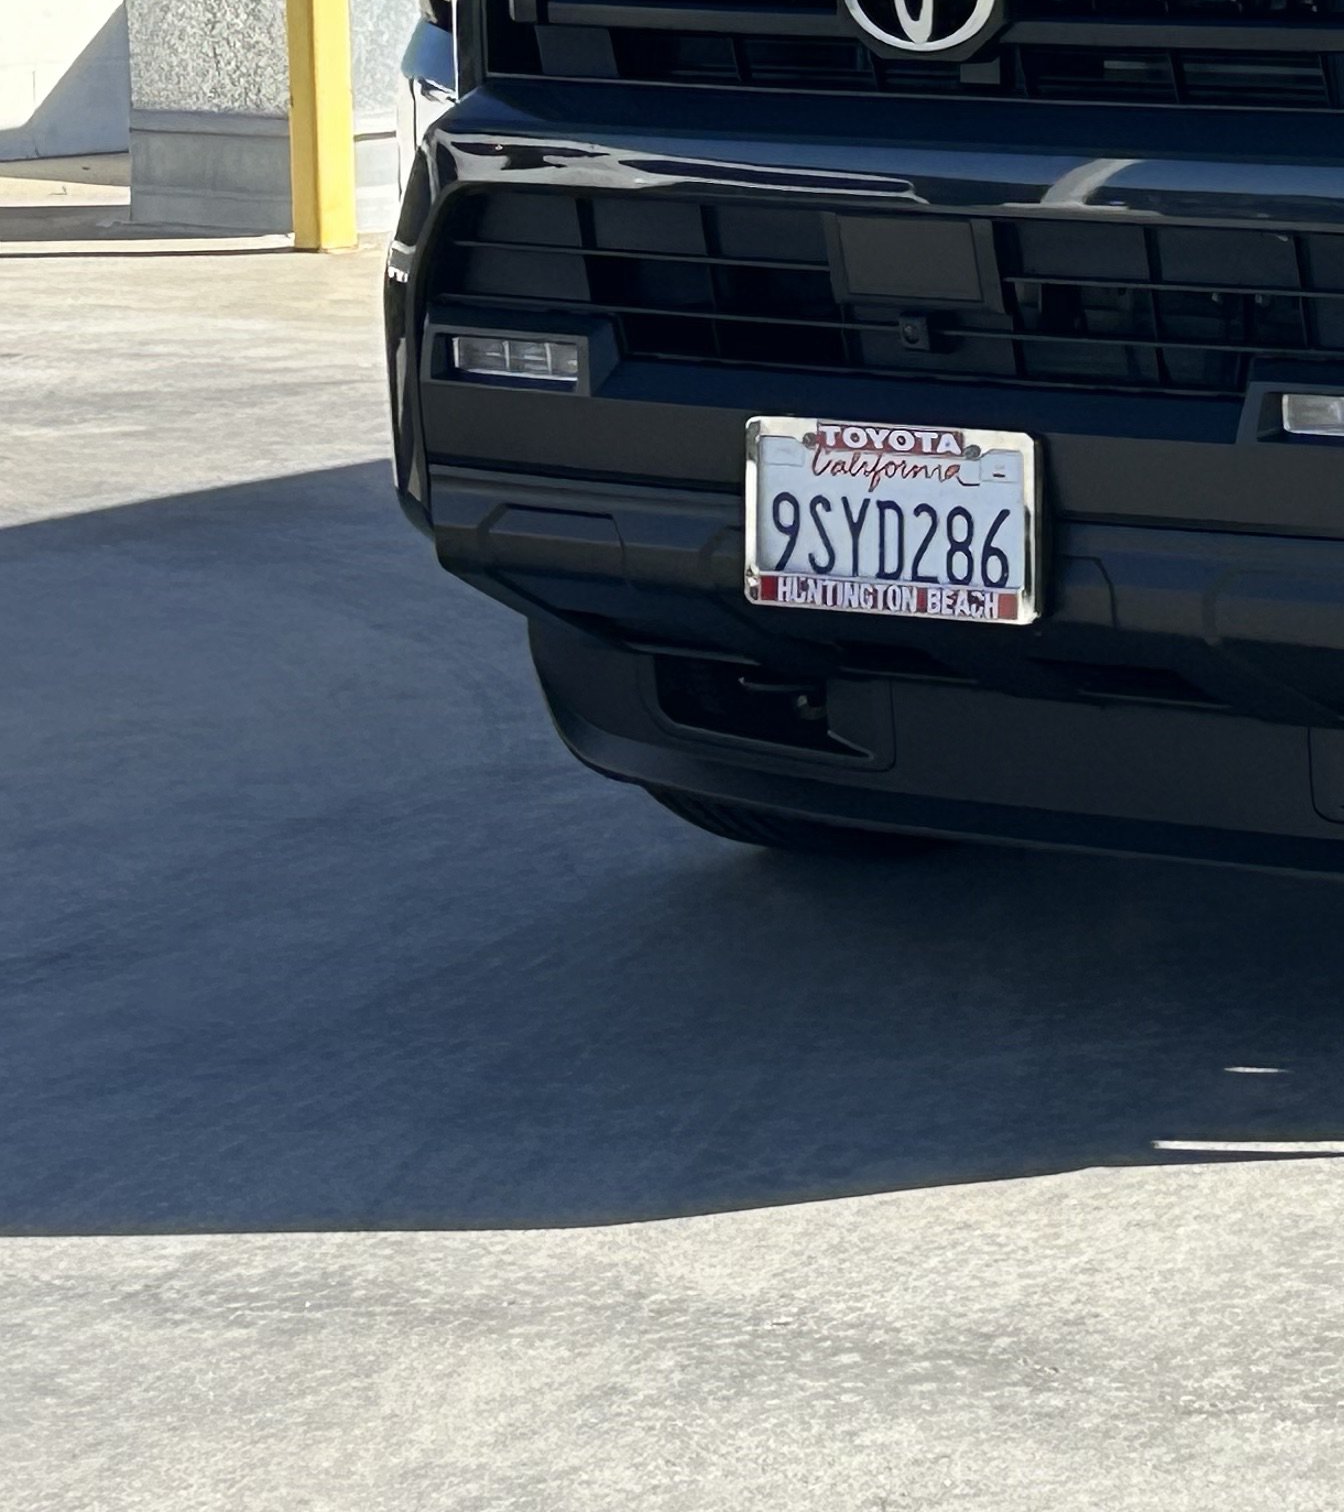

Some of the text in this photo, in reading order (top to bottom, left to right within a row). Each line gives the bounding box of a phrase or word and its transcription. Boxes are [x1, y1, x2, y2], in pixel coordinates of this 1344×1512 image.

[817, 425, 963, 455] TOYOTA
[811, 445, 981, 493] California
[772, 491, 1011, 589] 9SYD286
[777, 576, 999, 619] HUNTINGTON BEACH
